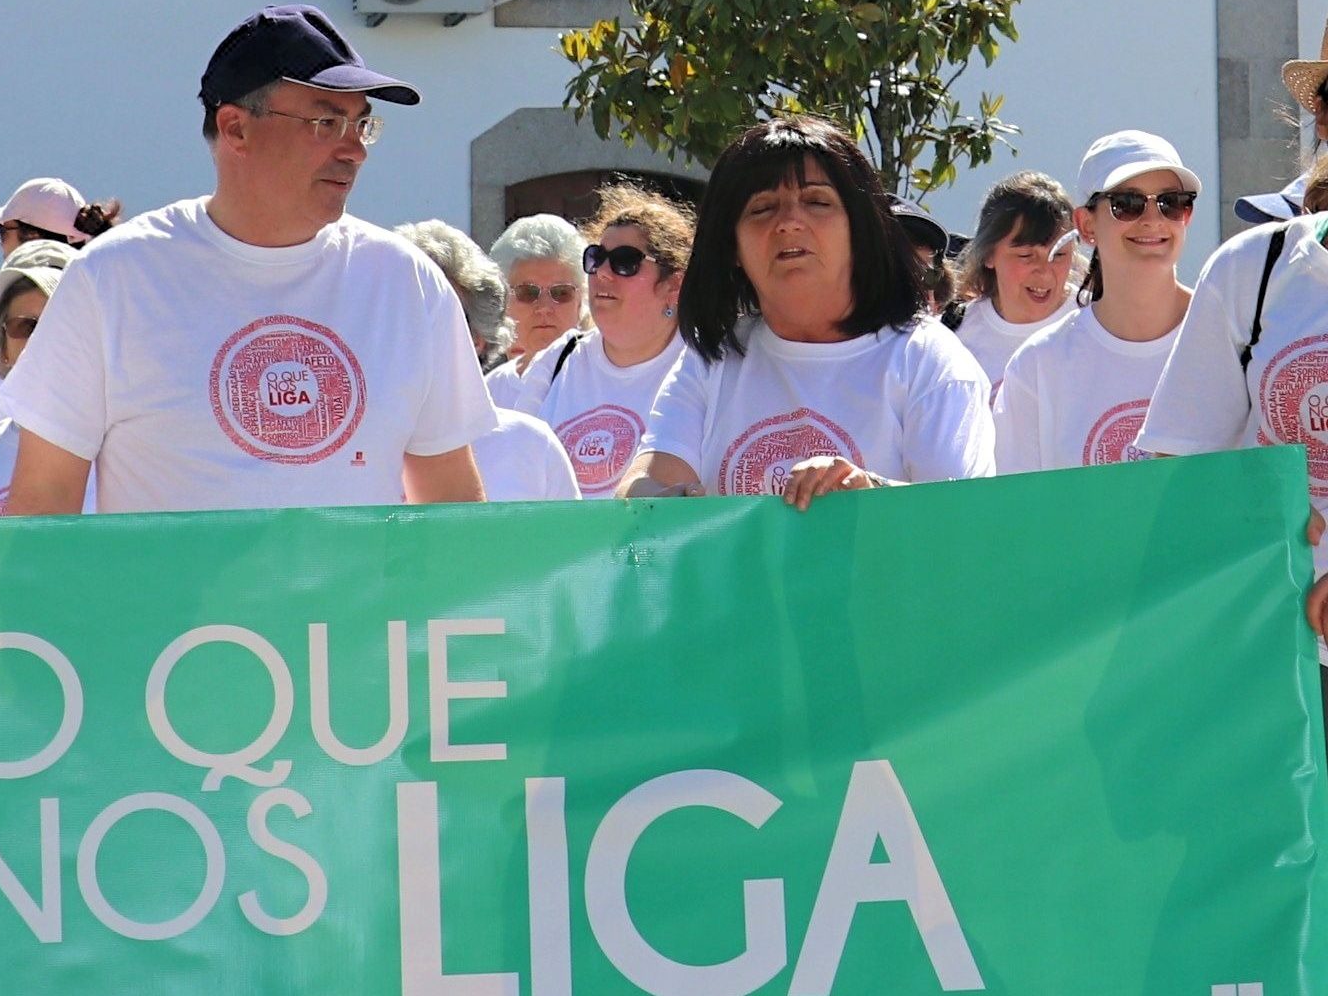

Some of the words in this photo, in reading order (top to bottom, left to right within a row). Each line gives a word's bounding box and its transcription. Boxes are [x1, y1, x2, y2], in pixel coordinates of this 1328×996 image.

[304, 355, 335, 365] AFETO
[266, 371, 278, 382] O
[281, 370, 309, 382] QUE
[267, 381, 297, 392] NOS
[269, 390, 311, 406] LIGA
[1308, 394, 1321, 407] O
[333, 396, 345, 421] VIDA
[578, 446, 605, 456] LIGA
[145, 618, 508, 792] QUE
[396, 759, 984, 996] LIGA
